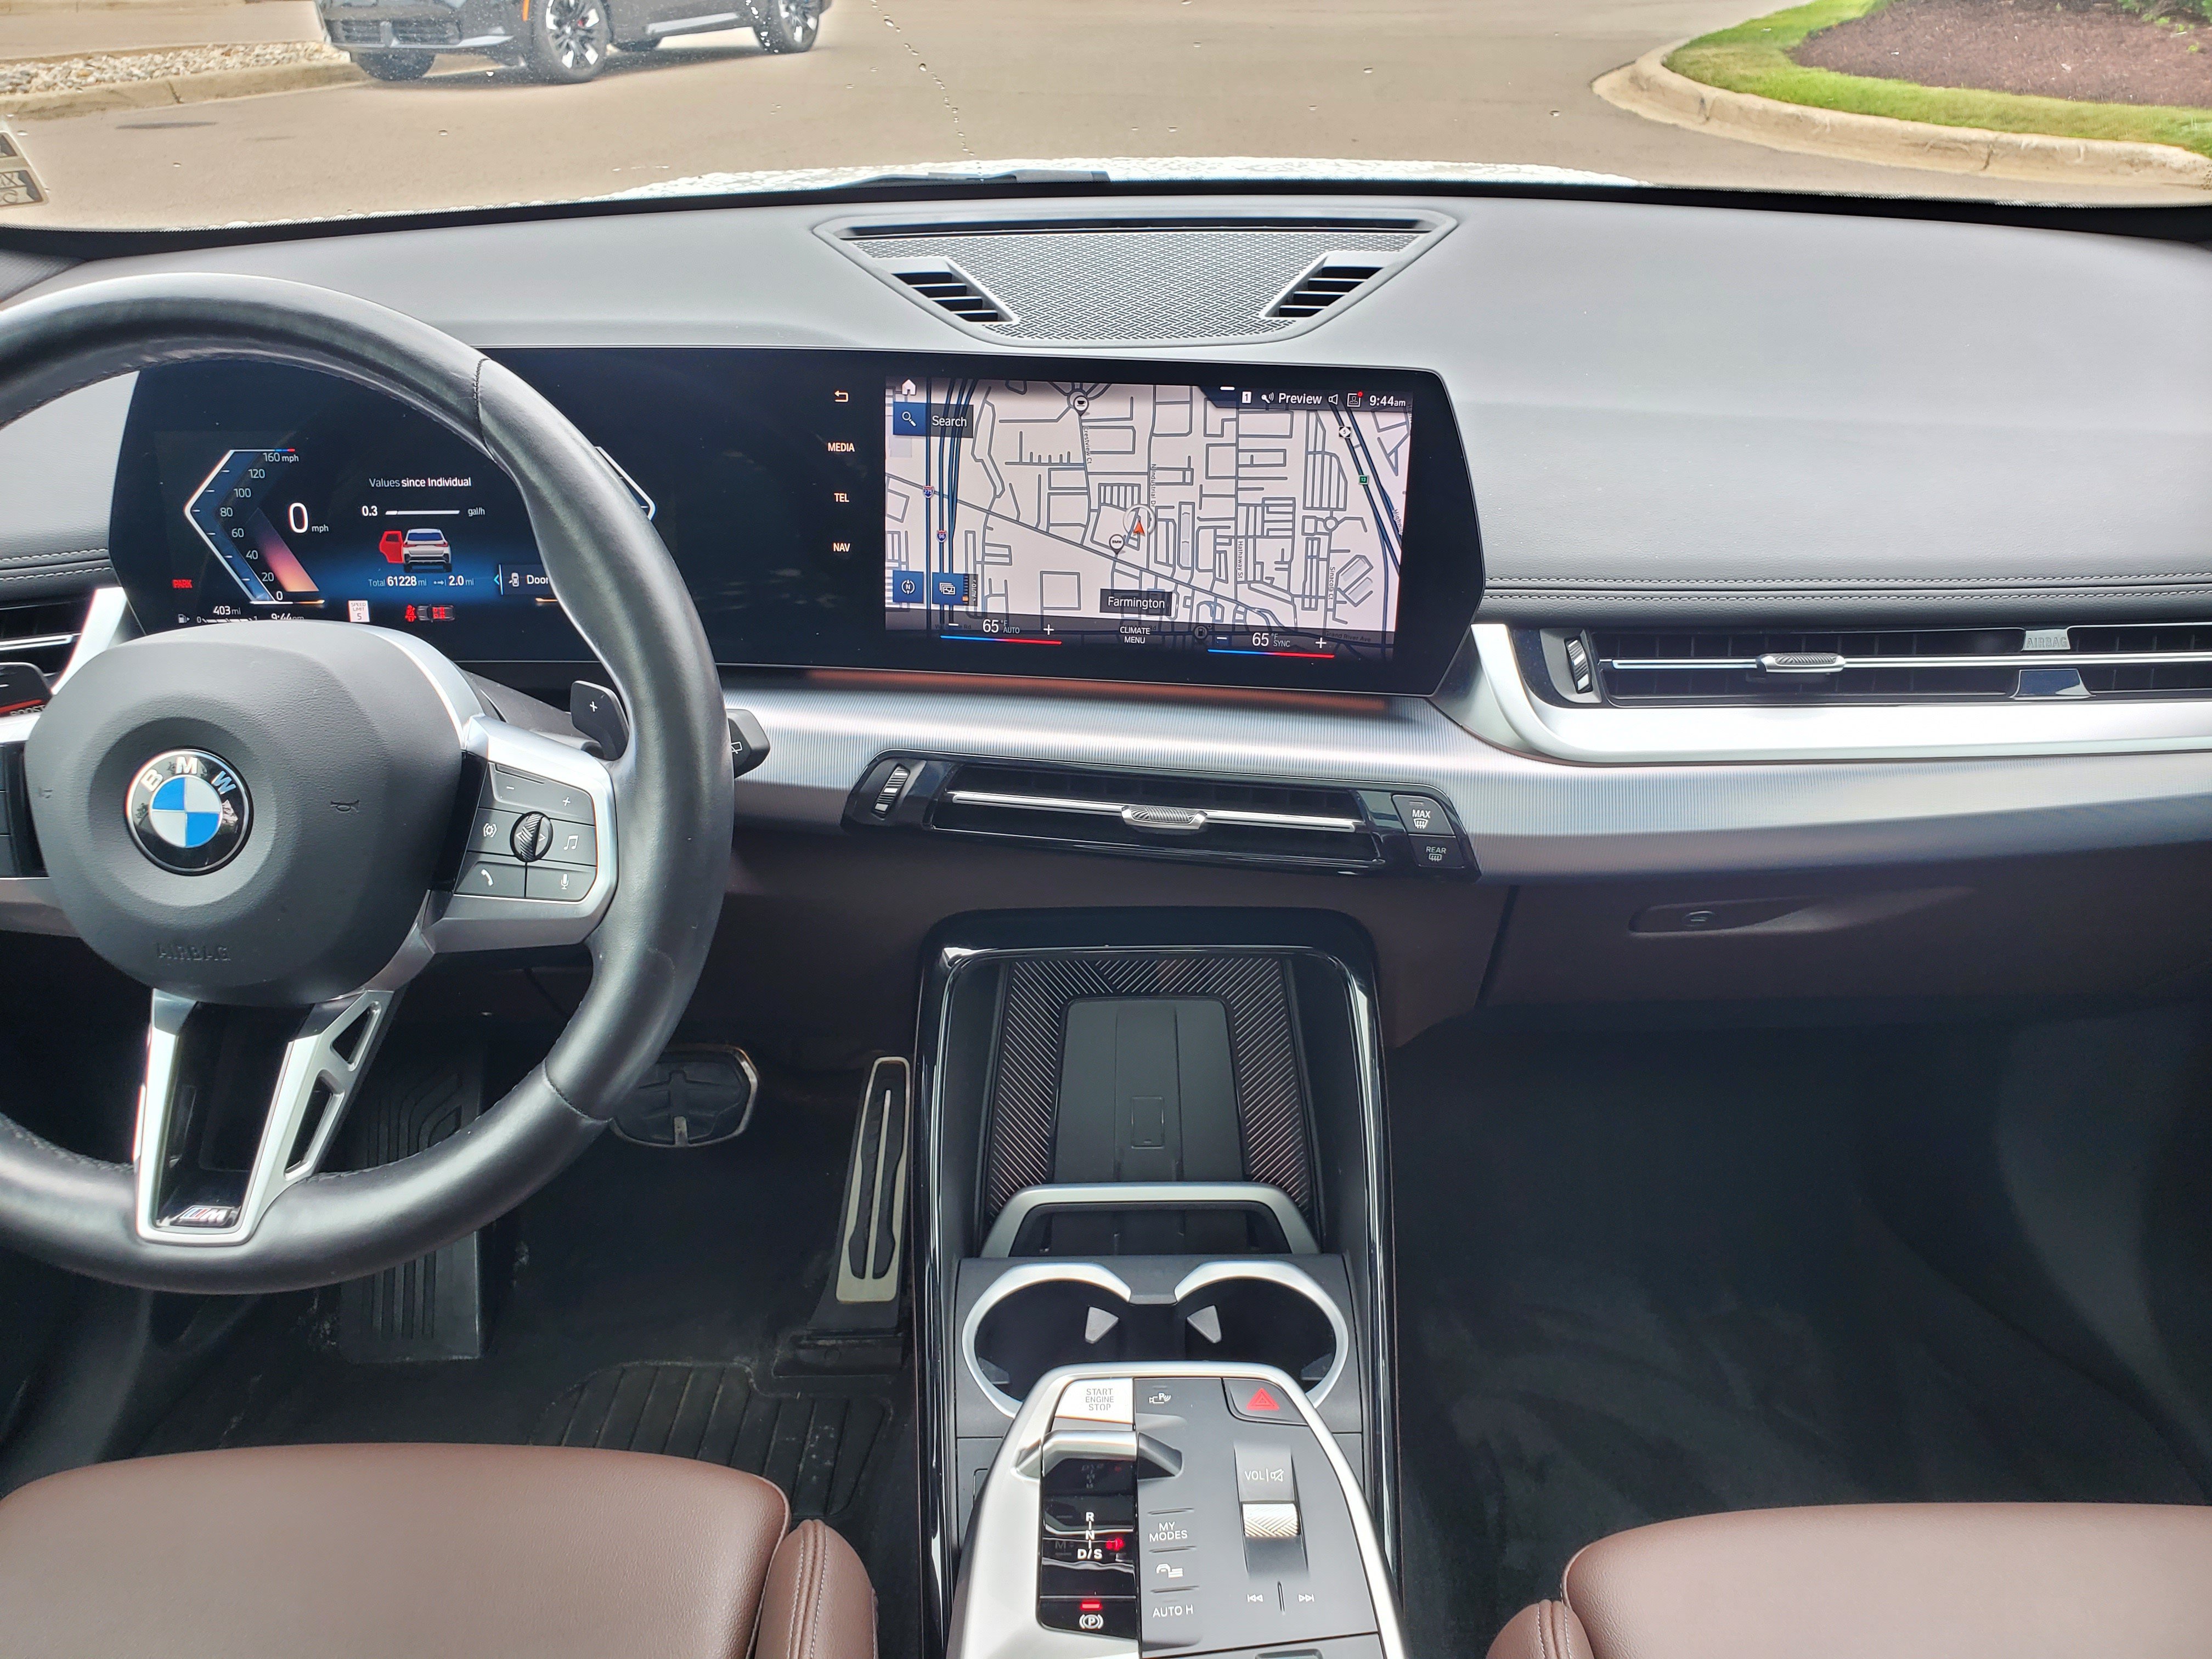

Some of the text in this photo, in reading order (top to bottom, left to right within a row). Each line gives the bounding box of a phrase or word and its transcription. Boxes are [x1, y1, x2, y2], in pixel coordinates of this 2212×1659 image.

[1278, 393, 1322, 404] Preview
[932, 415, 968, 427] Search
[1083, 426, 1092, 456] Crestview
[827, 442, 855, 452] MEDIA
[263, 453, 280, 462] 160
[248, 469, 265, 478] 120
[369, 477, 472, 487] Values since Individual
[234, 488, 251, 498] 100
[834, 493, 850, 503] TEL
[221, 507, 233, 517] 80
[362, 505, 378, 517] 0.3
[467, 507, 486, 516] gal/h
[289, 503, 309, 533] 0
[232, 528, 244, 538] 60
[833, 543, 850, 552] NAV
[246, 550, 258, 560] 40
[262, 572, 274, 582] 20
[387, 576, 417, 586] 61228
[449, 575, 464, 586] 2.0
[172, 579, 192, 588] PARK
[276, 591, 283, 601] 0
[1108, 596, 1165, 610] Farmington
[213, 606, 231, 615] 403
[982, 619, 999, 633] 65
[1003, 626, 1020, 634] AUTO
[1120, 626, 1150, 635] CLIMATE
[1252, 632, 1269, 646] 65
[2027, 637, 2067, 648] AIRBAG
[140, 756, 236, 795] BMW
[1412, 809, 1431, 819] MAX
[1426, 846, 1447, 854] REAR
[156, 943, 231, 961] AIRBAG
[1244, 1470, 1265, 1481] VOL
[1086, 1511, 1094, 1522] R
[1159, 1521, 1175, 1531] MY
[1086, 1530, 1095, 1540] N
[1149, 1530, 1188, 1542] MODES
[1077, 1548, 1103, 1559] D/S
[1153, 1604, 1193, 1618] AUTO H
